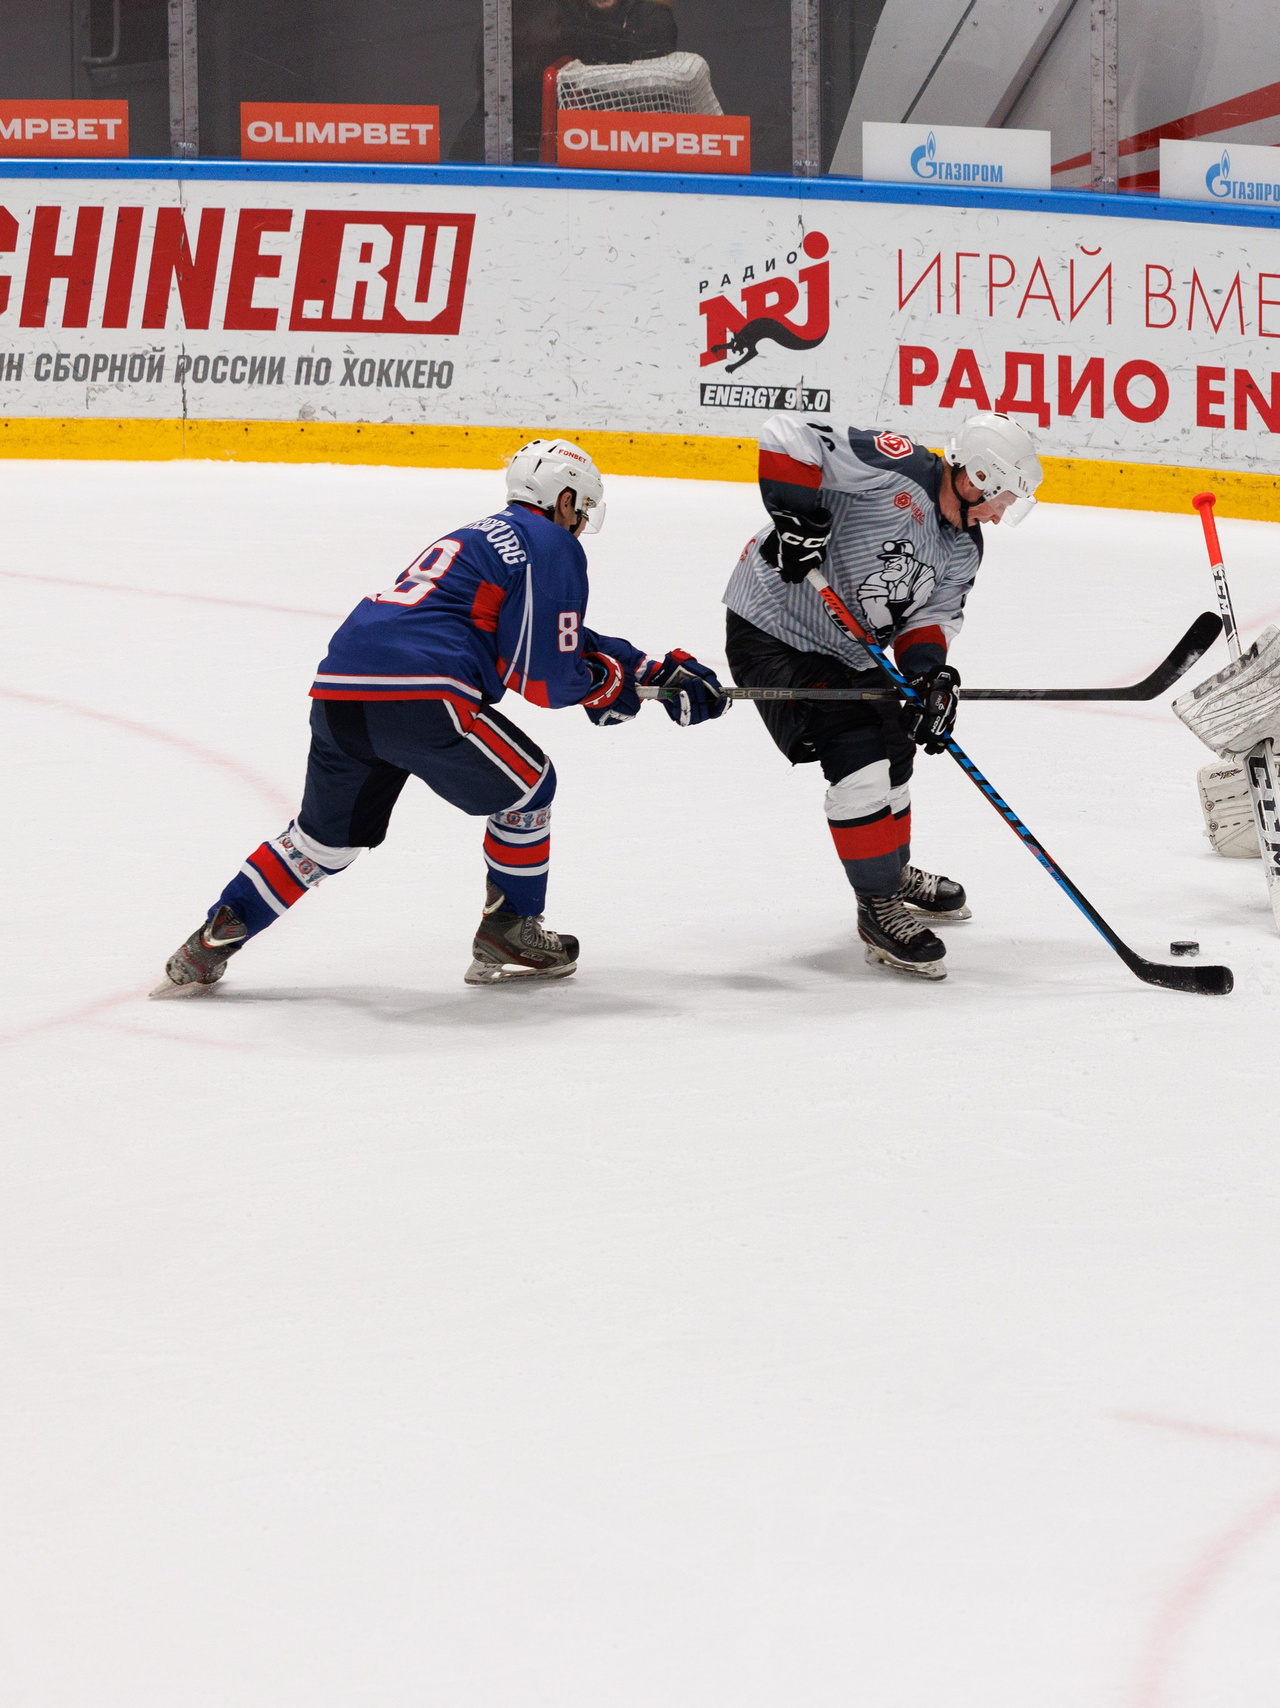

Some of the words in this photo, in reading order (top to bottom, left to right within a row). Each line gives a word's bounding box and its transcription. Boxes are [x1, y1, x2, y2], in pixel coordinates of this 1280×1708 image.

[247, 120, 434, 146] OLIMPBET
[563, 128, 745, 157] OLIMPBET
[938, 162, 1003, 183] ГАЗПРОМ
[698, 250, 798, 294] РАДИО
[897, 246, 1113, 325] ИГРАЙ
[33, 345, 166, 384] СБОРНОЙ
[174, 353, 287, 386] РОССИИ
[294, 356, 333, 387] ПО
[339, 357, 455, 390] ХОККЕЮ
[702, 384, 781, 408] ENERGY
[898, 344, 1171, 428] РАДИО
[557, 448, 587, 464] FONBET
